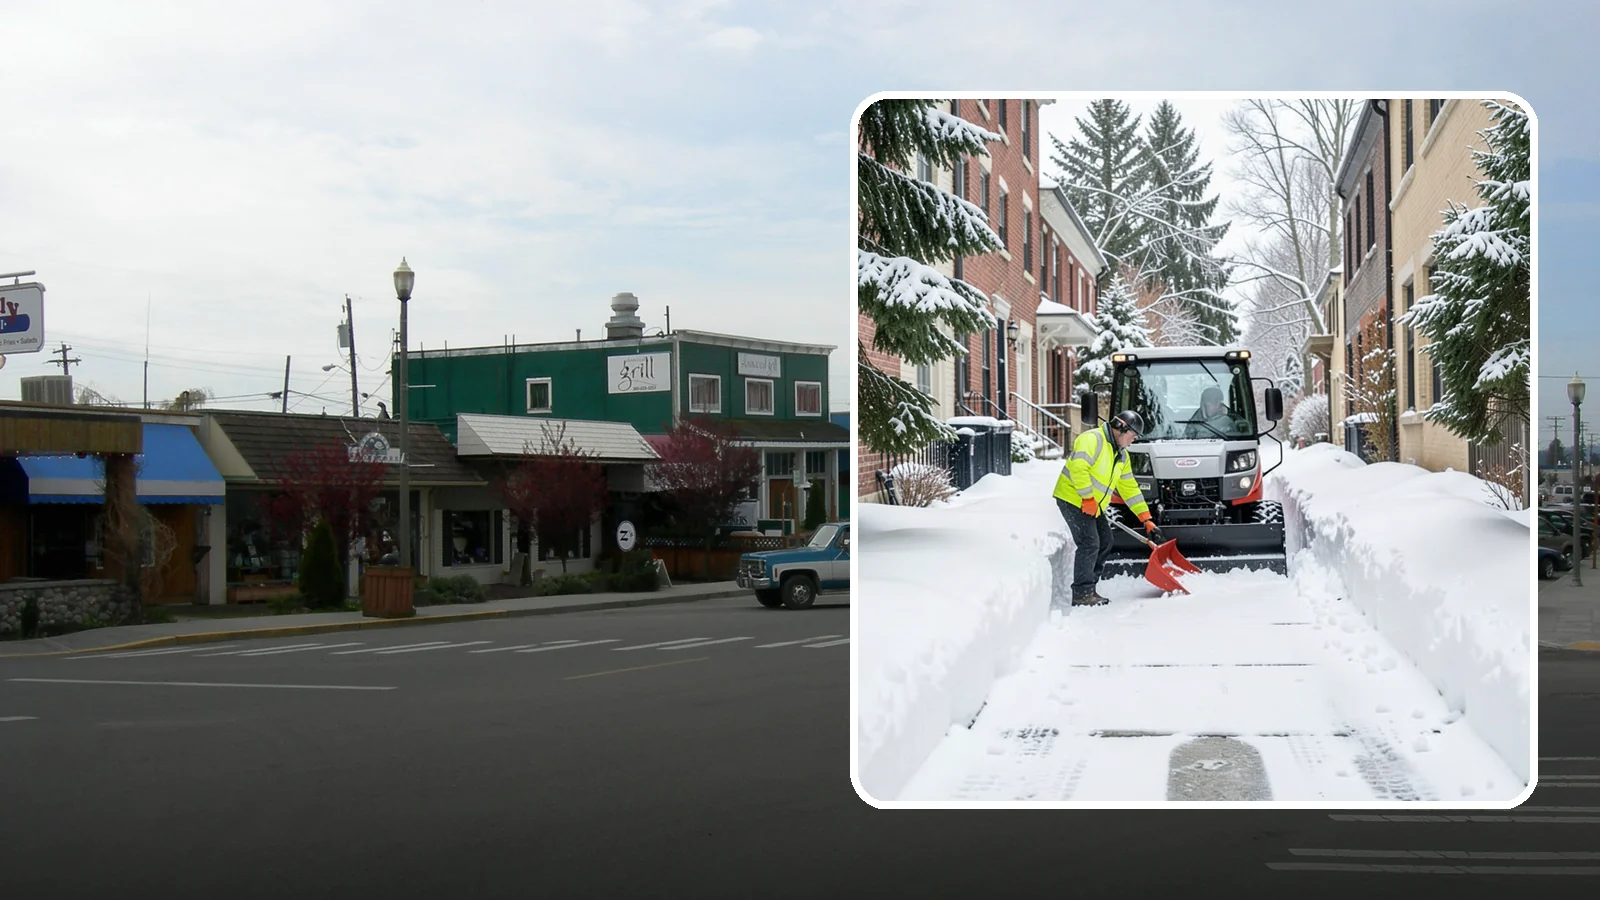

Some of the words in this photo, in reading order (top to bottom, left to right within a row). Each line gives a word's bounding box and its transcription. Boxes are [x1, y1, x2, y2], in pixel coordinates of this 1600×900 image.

[0, 297, 19, 324] ly
[20, 337, 38, 345] Salads
[618, 356, 655, 391] grill
